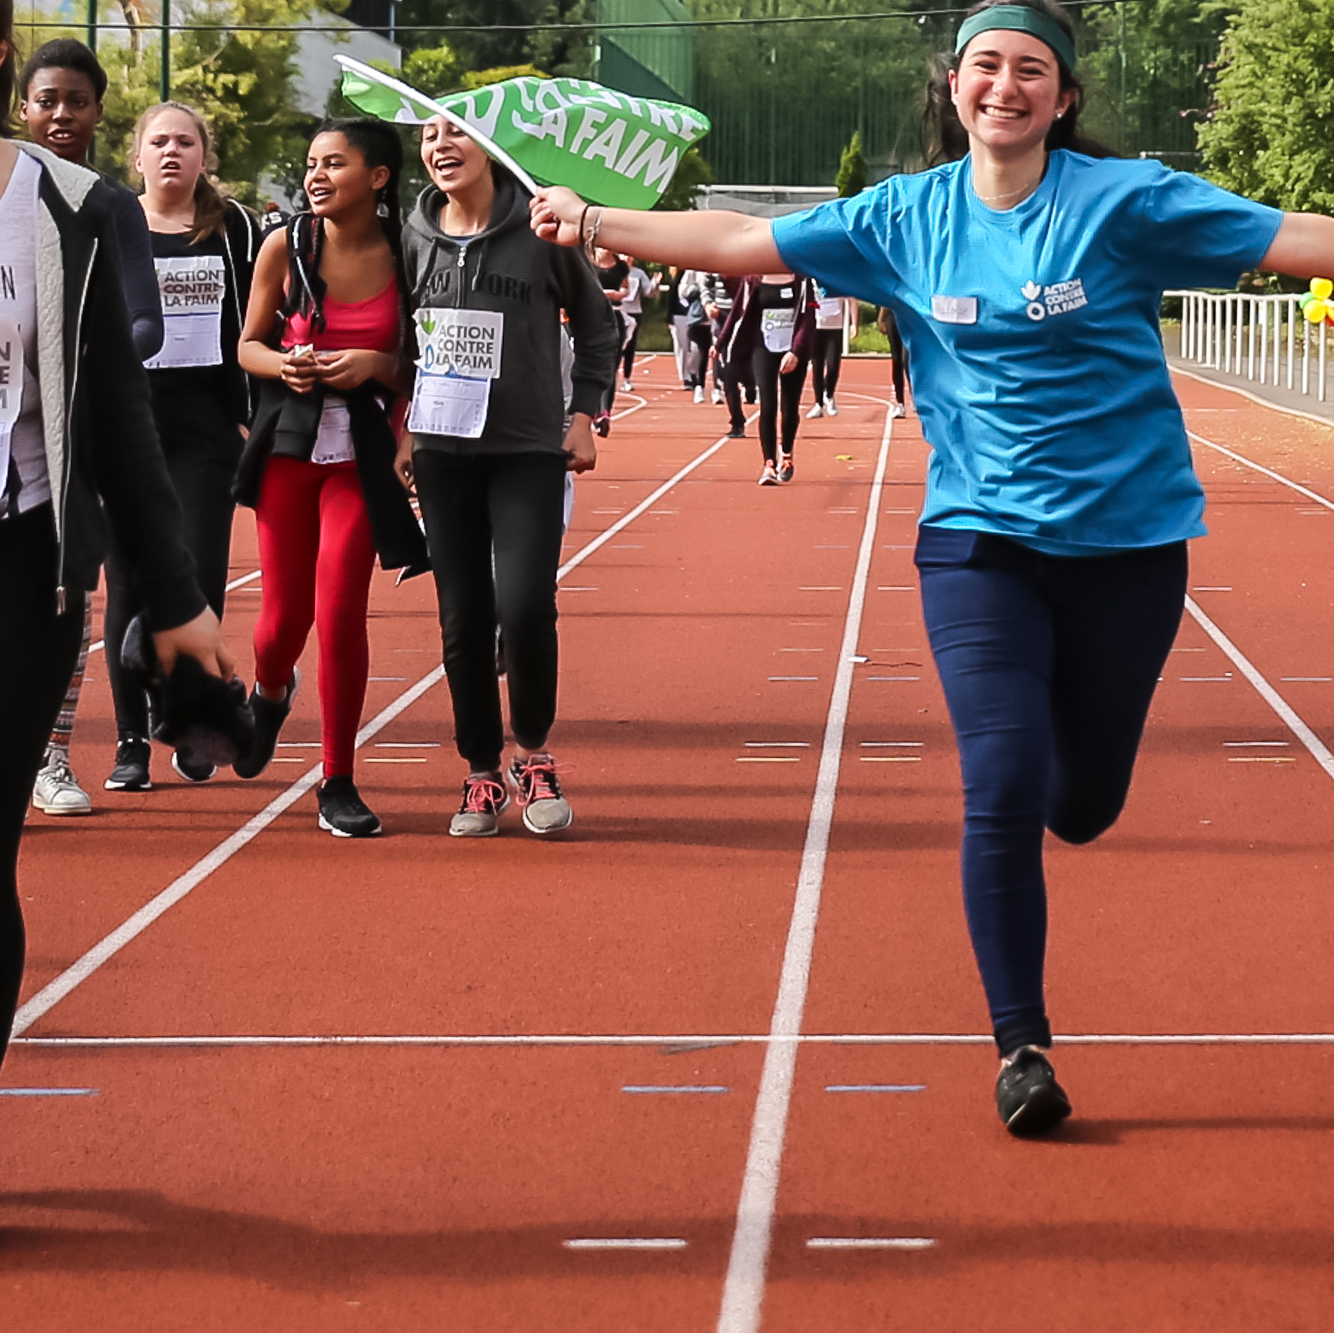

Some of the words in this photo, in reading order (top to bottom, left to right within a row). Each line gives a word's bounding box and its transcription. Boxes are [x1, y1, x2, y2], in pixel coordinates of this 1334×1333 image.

[511, 107, 567, 148] LA
[569, 107, 679, 194] FAIM
[164, 270, 219, 282] ACTION
[163, 283, 220, 294] CONTRE
[1044, 277, 1082, 296] ACTION
[164, 295, 181, 306] LA
[185, 294, 219, 306] FAIM
[1047, 303, 1063, 315] LA
[439, 324, 495, 340] ACTION
[438, 340, 494, 354] CONTRE
[436, 353, 450, 365] LA
[454, 354, 493, 369] FAIM
